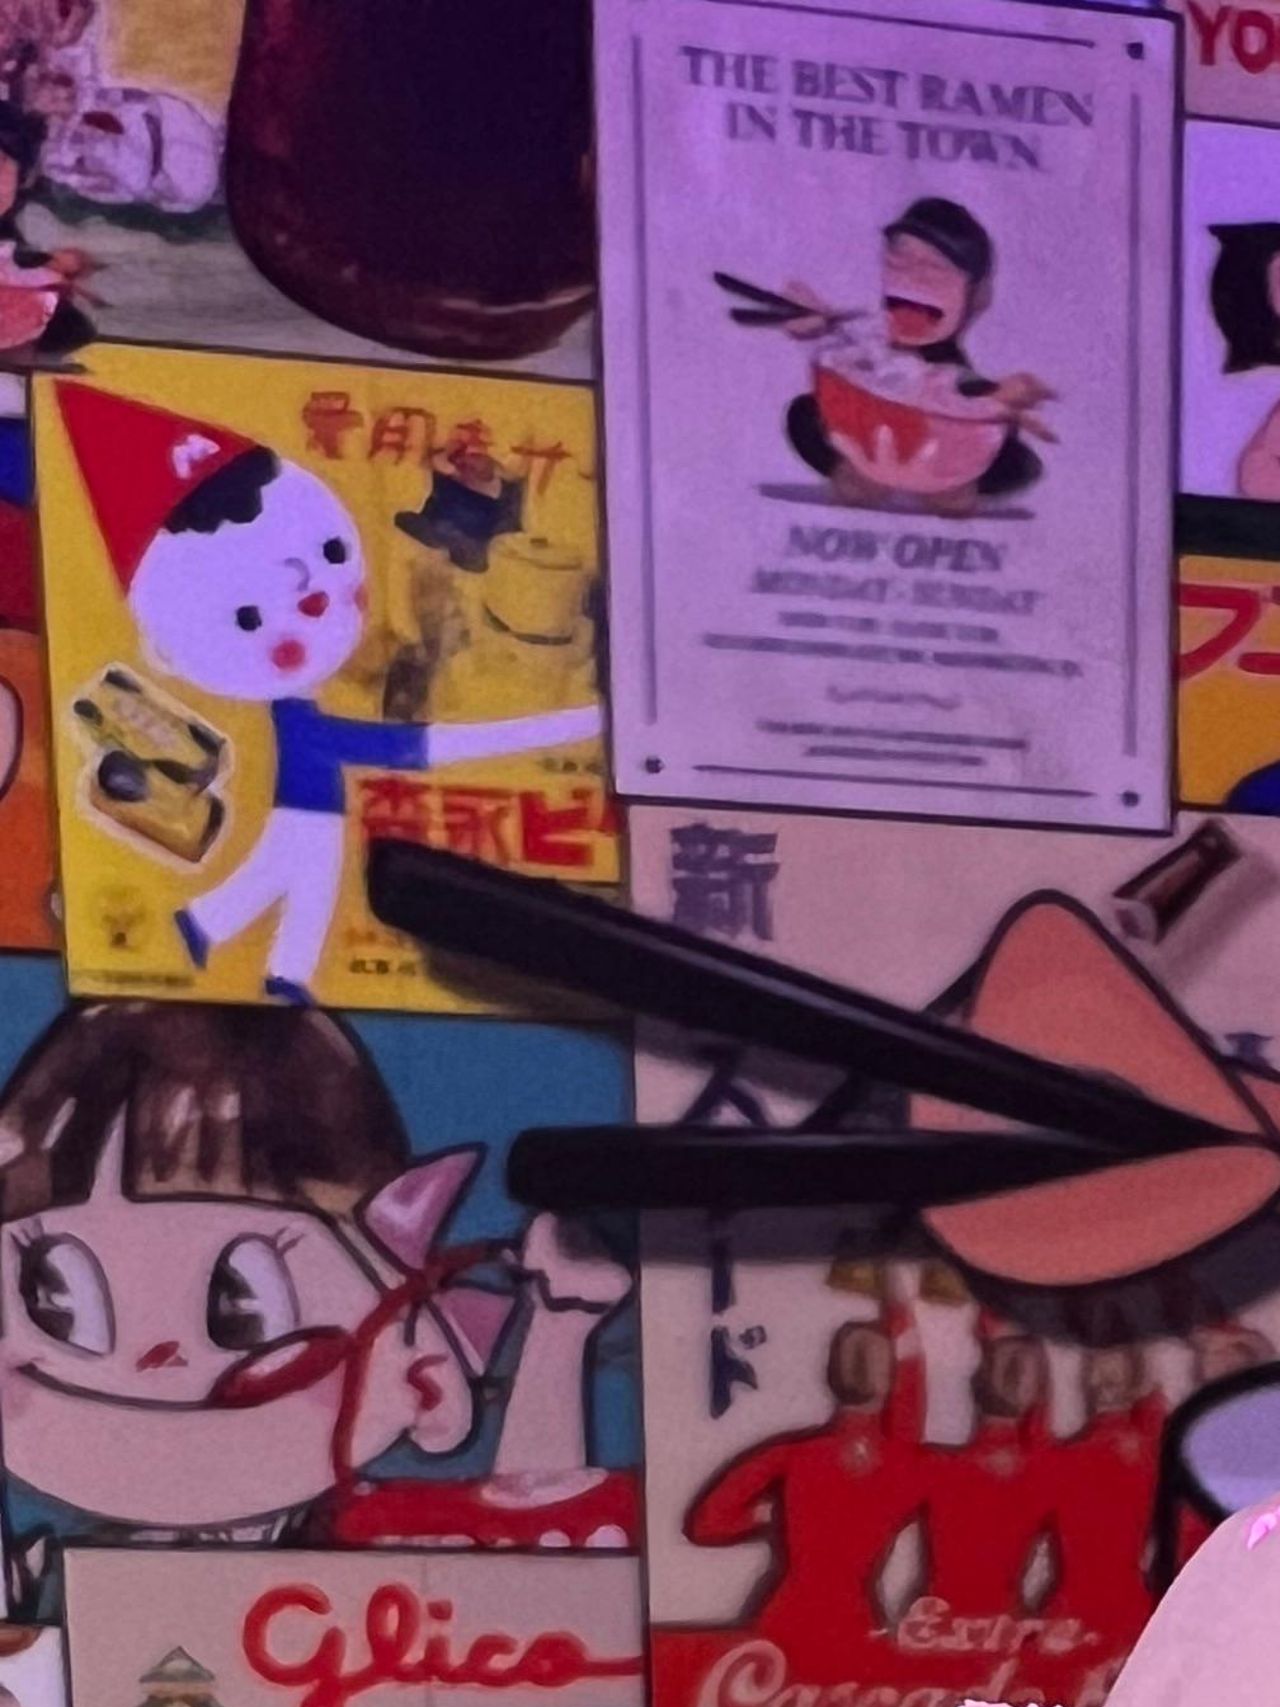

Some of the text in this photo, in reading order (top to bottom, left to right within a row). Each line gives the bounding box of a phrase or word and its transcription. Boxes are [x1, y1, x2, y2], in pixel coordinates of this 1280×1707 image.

[679, 45, 1094, 127] THE BEST RAMEN
[726, 102, 777, 142] IN
[791, 108, 888, 156] THE
